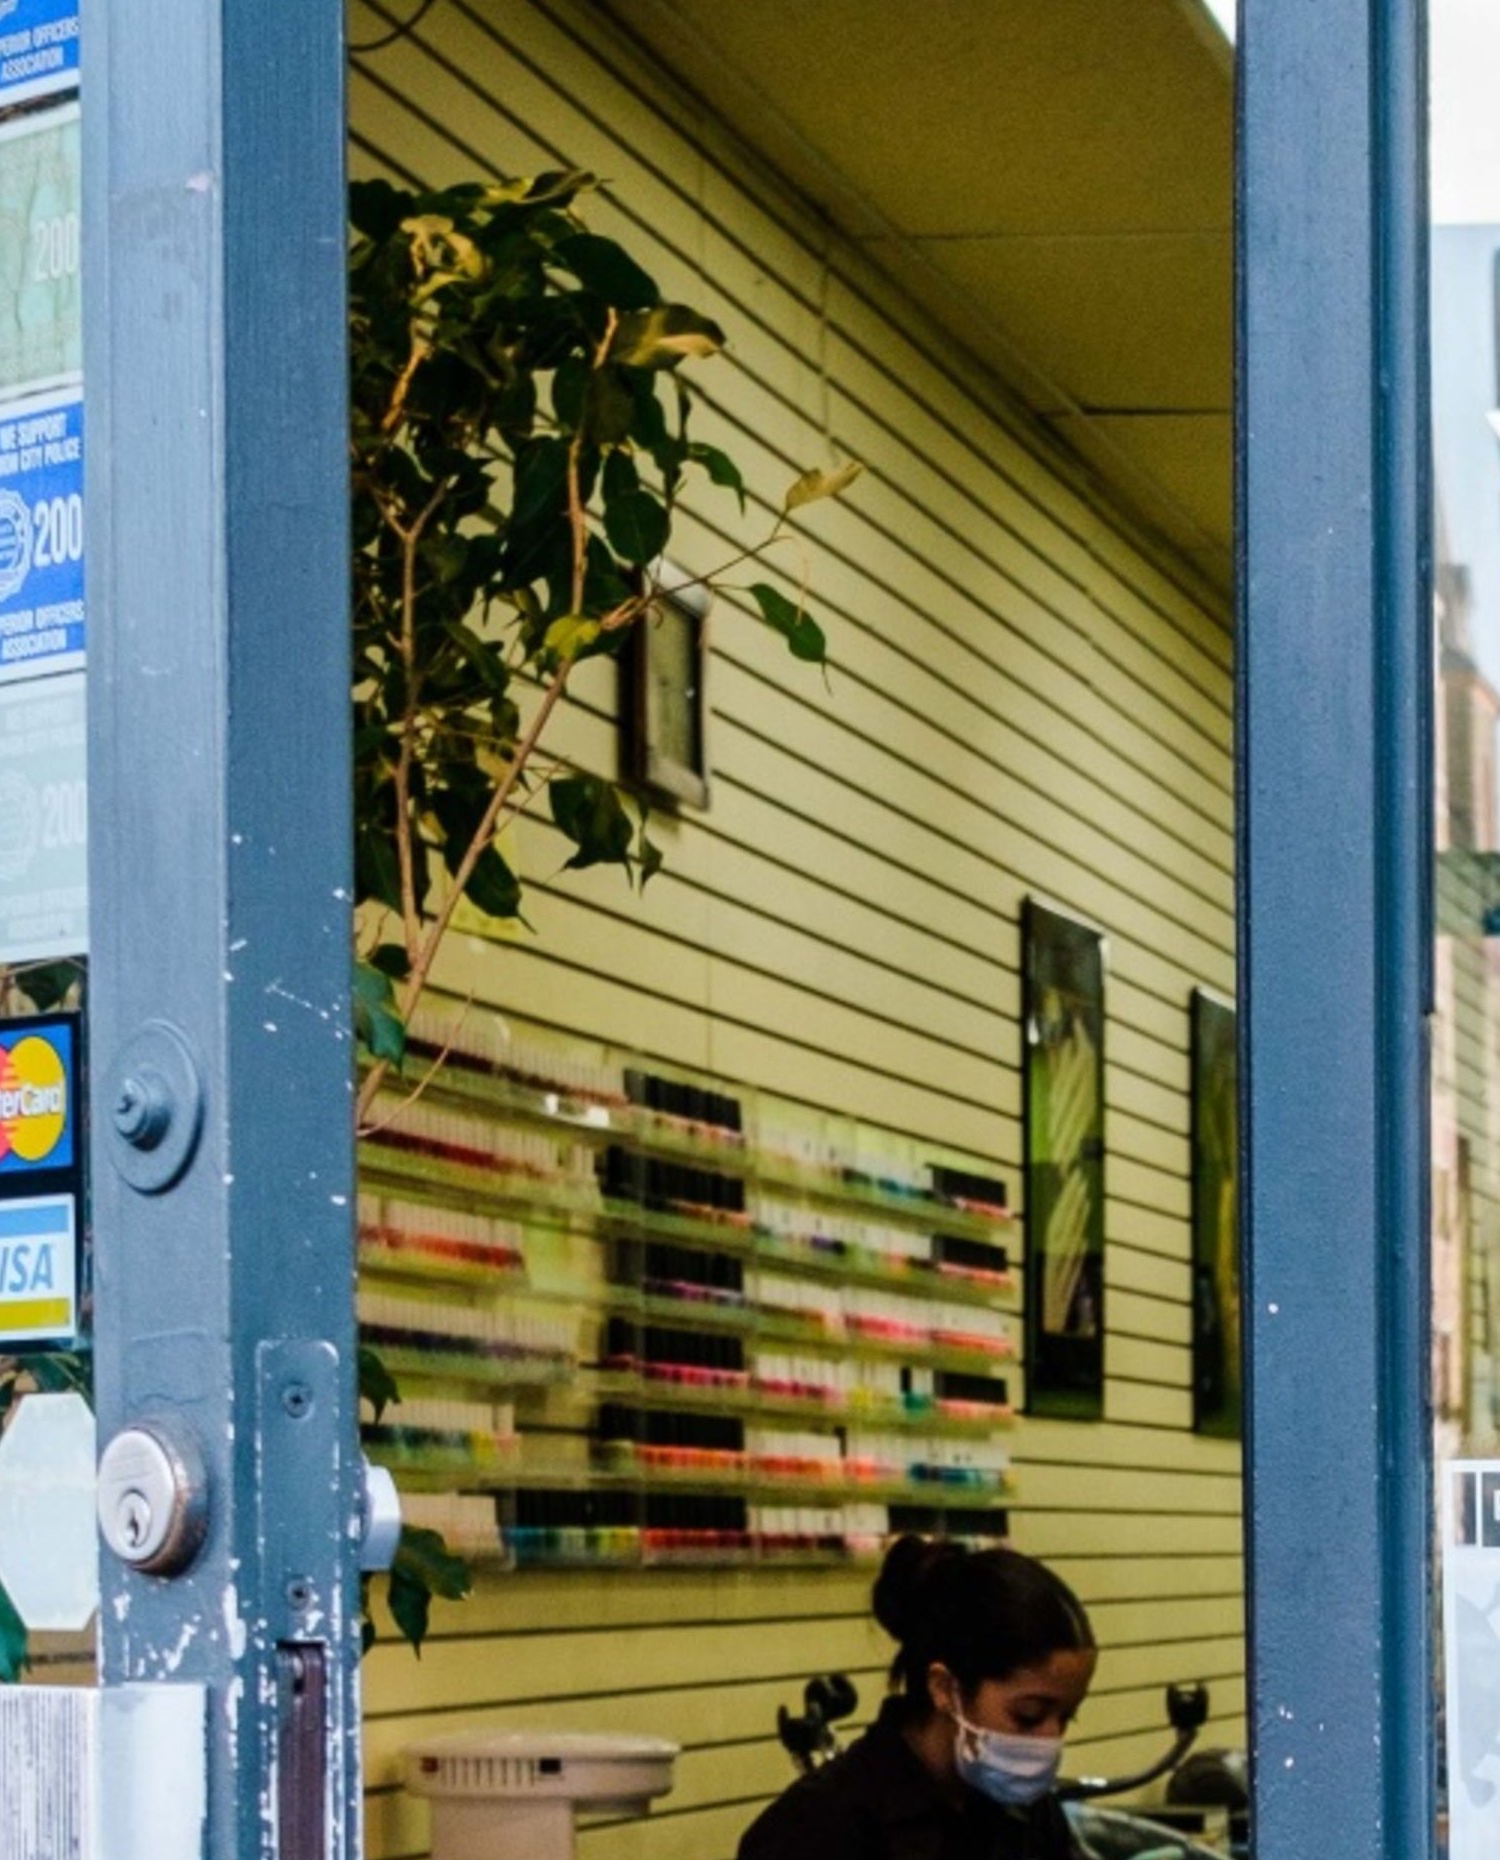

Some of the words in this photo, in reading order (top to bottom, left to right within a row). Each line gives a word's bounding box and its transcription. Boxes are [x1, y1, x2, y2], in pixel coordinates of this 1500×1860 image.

[0, 424, 16, 451] WE
[18, 412, 67, 447] SUPPORT
[20, 445, 43, 472] CITY
[44, 437, 82, 465] POLICE
